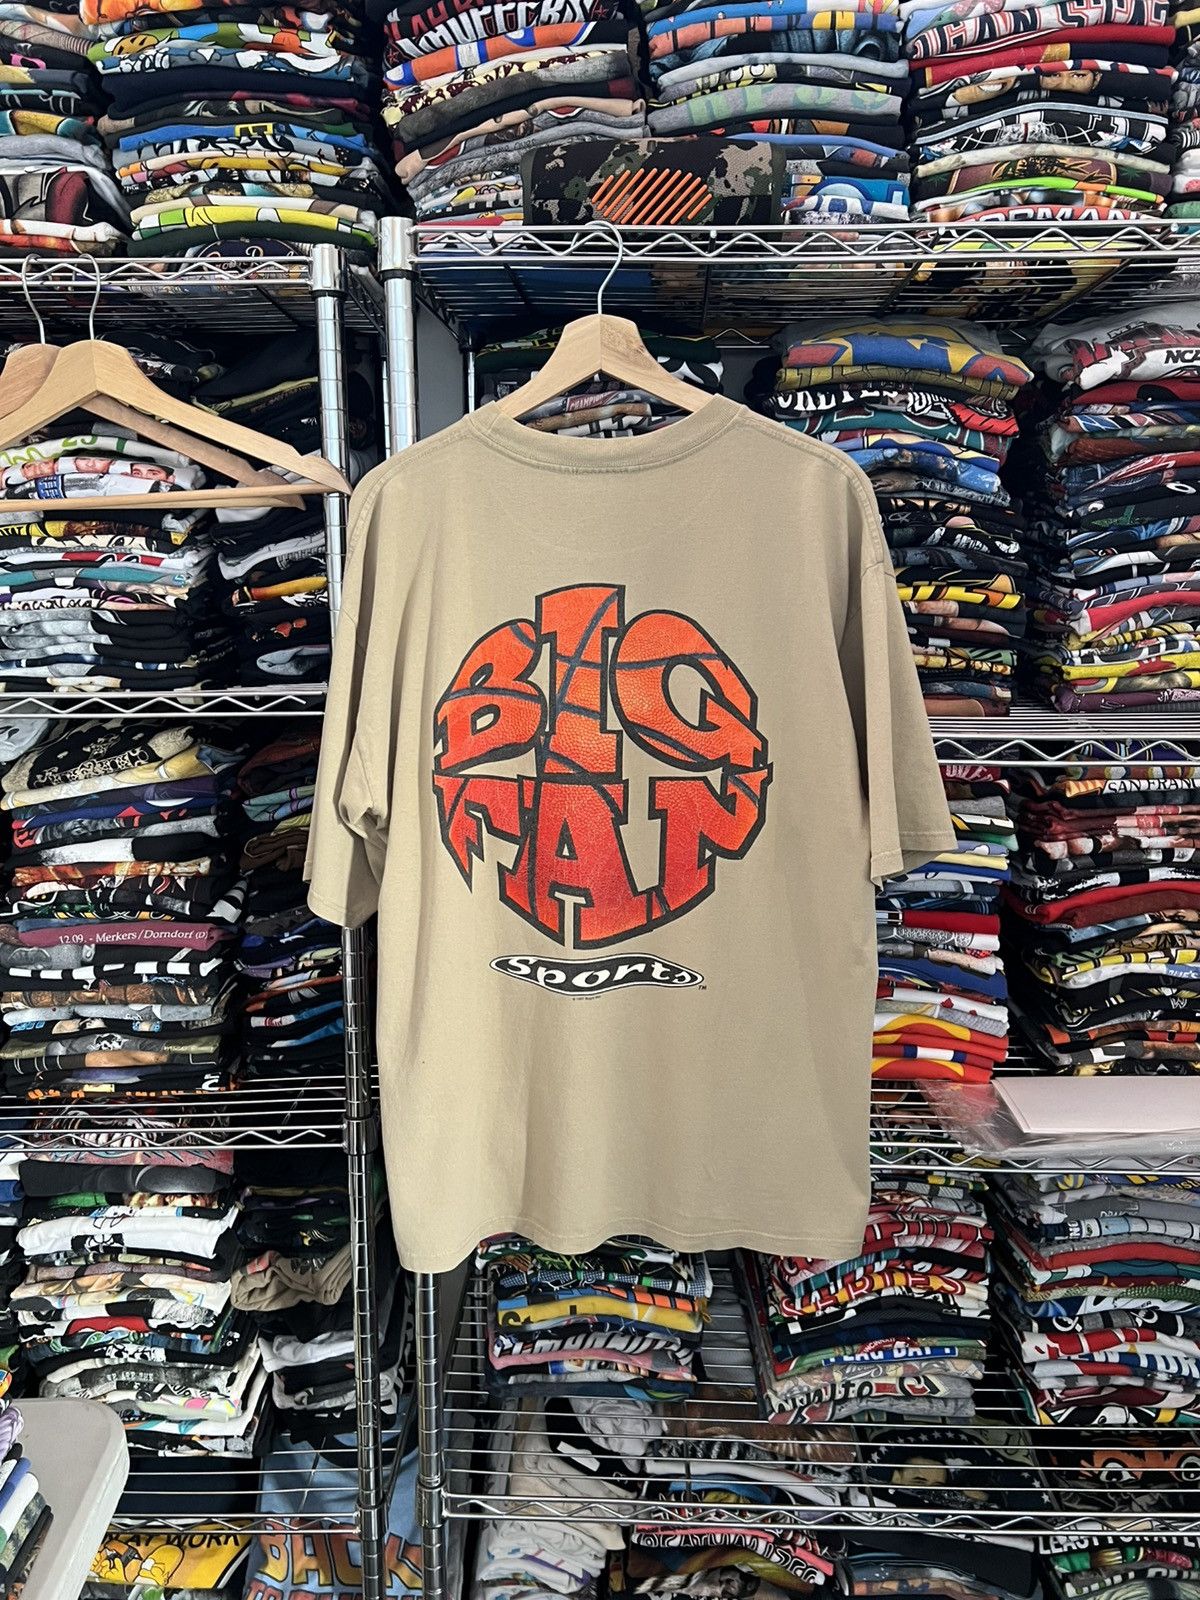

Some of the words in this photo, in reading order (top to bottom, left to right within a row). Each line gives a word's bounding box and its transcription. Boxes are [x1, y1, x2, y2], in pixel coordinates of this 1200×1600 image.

[433, 583, 769, 778] BIG
[433, 762, 774, 950] FAN
[507, 956, 691, 986] Sports
